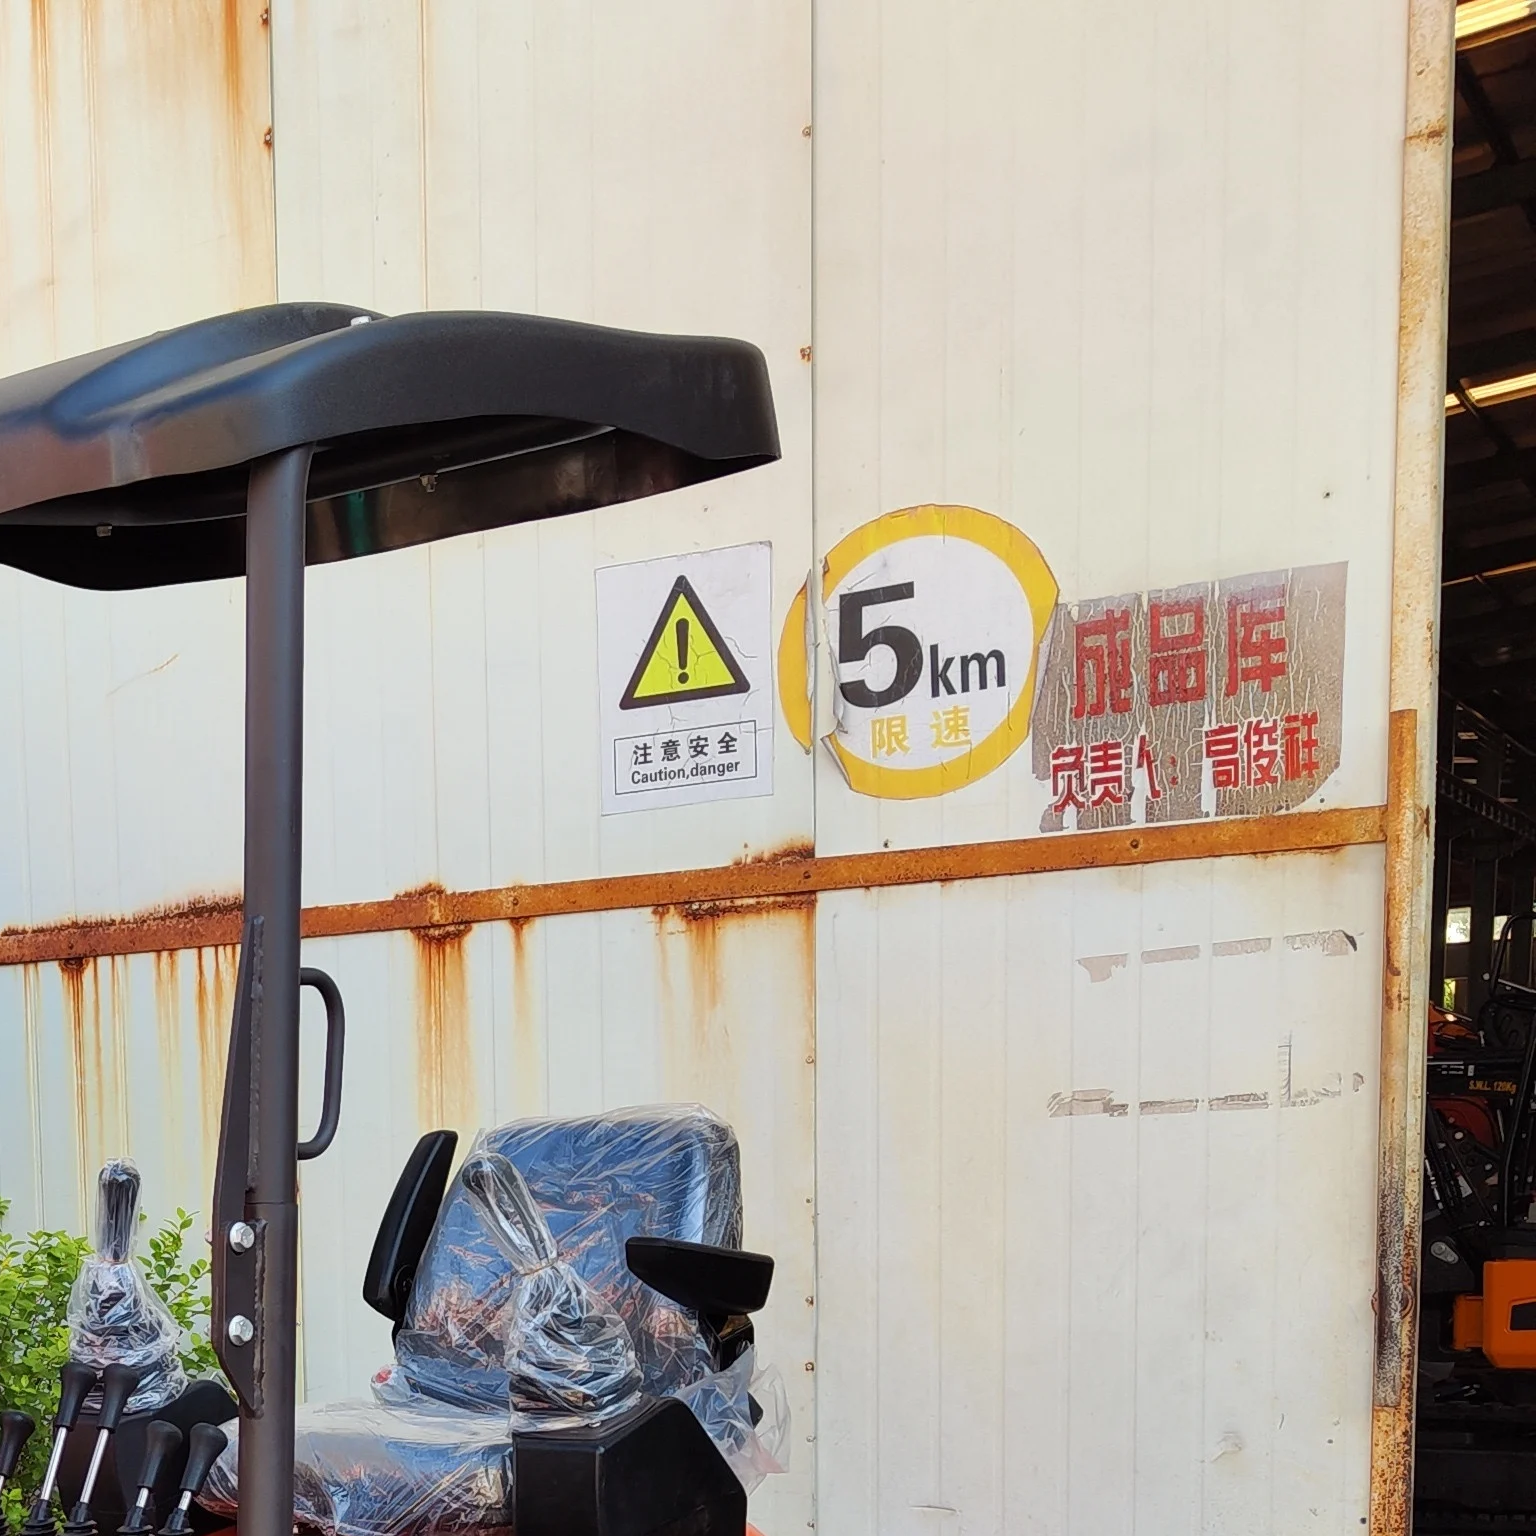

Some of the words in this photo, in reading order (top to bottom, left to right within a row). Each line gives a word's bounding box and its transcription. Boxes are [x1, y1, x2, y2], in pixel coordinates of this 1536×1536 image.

[1072, 584, 1287, 721] 成品库
[632, 731, 738, 766] 注意安全
[870, 705, 972, 759] 限速
[631, 760, 741, 785] Caution,danger
